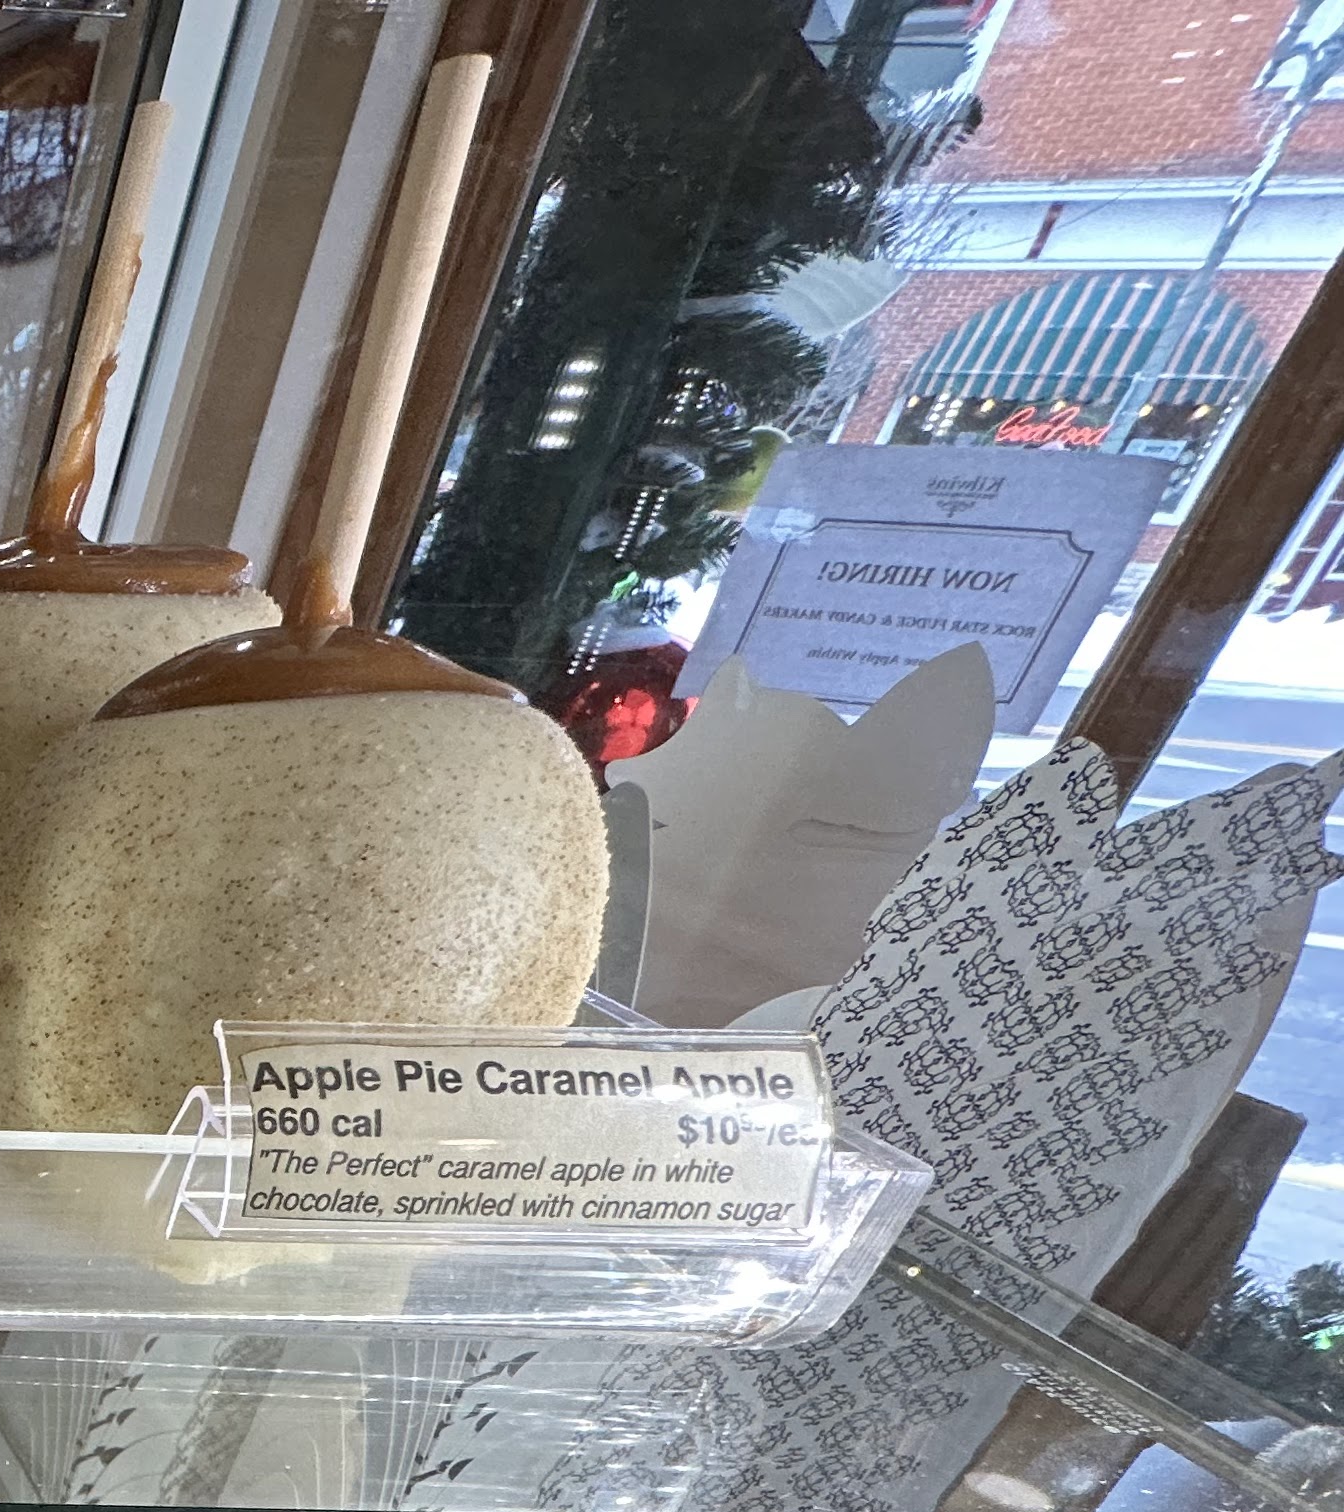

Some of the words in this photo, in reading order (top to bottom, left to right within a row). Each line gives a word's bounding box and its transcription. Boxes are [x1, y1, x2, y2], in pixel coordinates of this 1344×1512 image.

[252, 1058, 381, 1100] Apple
[394, 1060, 463, 1093] Pie
[475, 1060, 653, 1098] Caramel
[672, 1066, 794, 1104] Apple
[257, 1106, 320, 1136] 660
[331, 1108, 382, 1138] cal
[259, 1149, 318, 1175] "The
[326, 1151, 434, 1178] Perfect"
[437, 1156, 546, 1181] caramel
[551, 1157, 624, 1188] apple
[631, 1157, 656, 1182] in
[666, 1158, 734, 1184] white
[249, 1186, 385, 1218] chocolate,
[393, 1192, 516, 1221] sprinkled
[523, 1192, 574, 1219] with
[581, 1194, 711, 1221] cinnamon
[717, 1201, 796, 1227] sugar
